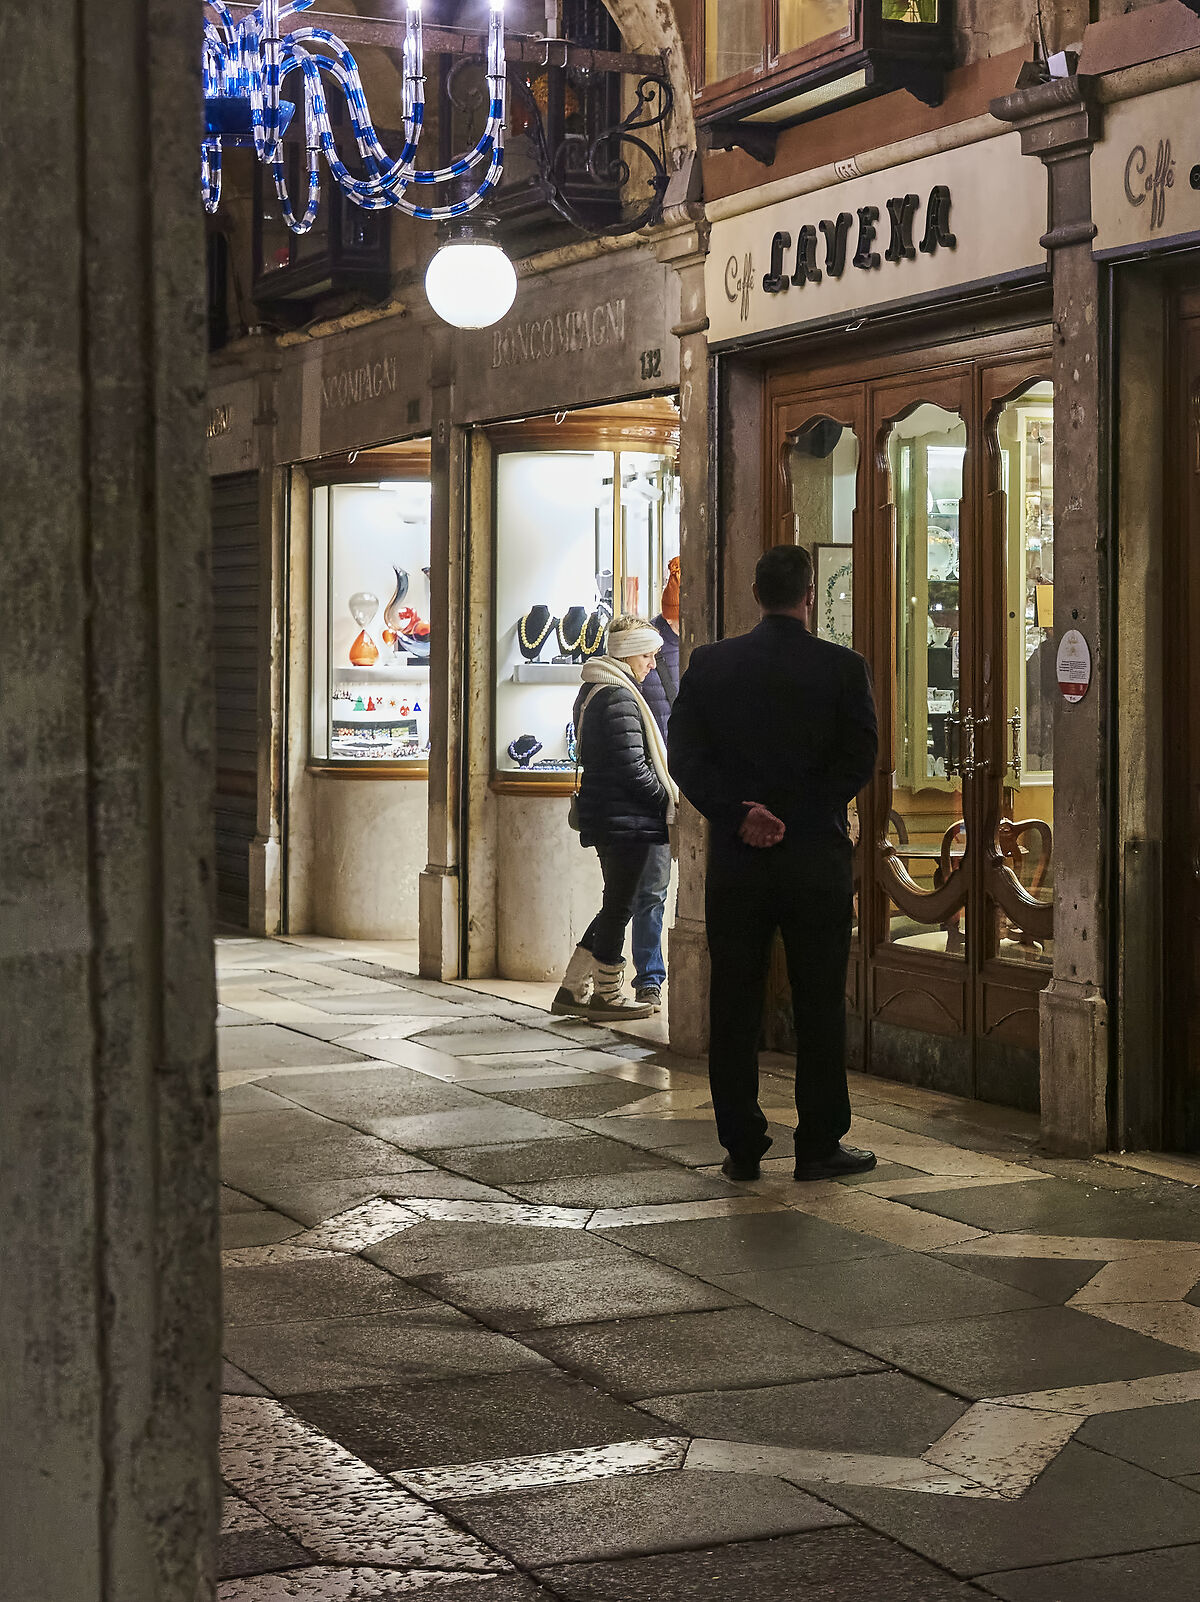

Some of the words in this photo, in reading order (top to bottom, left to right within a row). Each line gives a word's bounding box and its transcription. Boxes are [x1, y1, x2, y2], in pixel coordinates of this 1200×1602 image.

[838, 163, 858, 179] 133
[1124, 138, 1177, 231] Caffè
[724, 251, 755, 322] Caffè
[762, 184, 957, 294] LAVENA
[491, 298, 627, 369] BONCOMPAGNI
[639, 348, 662, 380] 132
